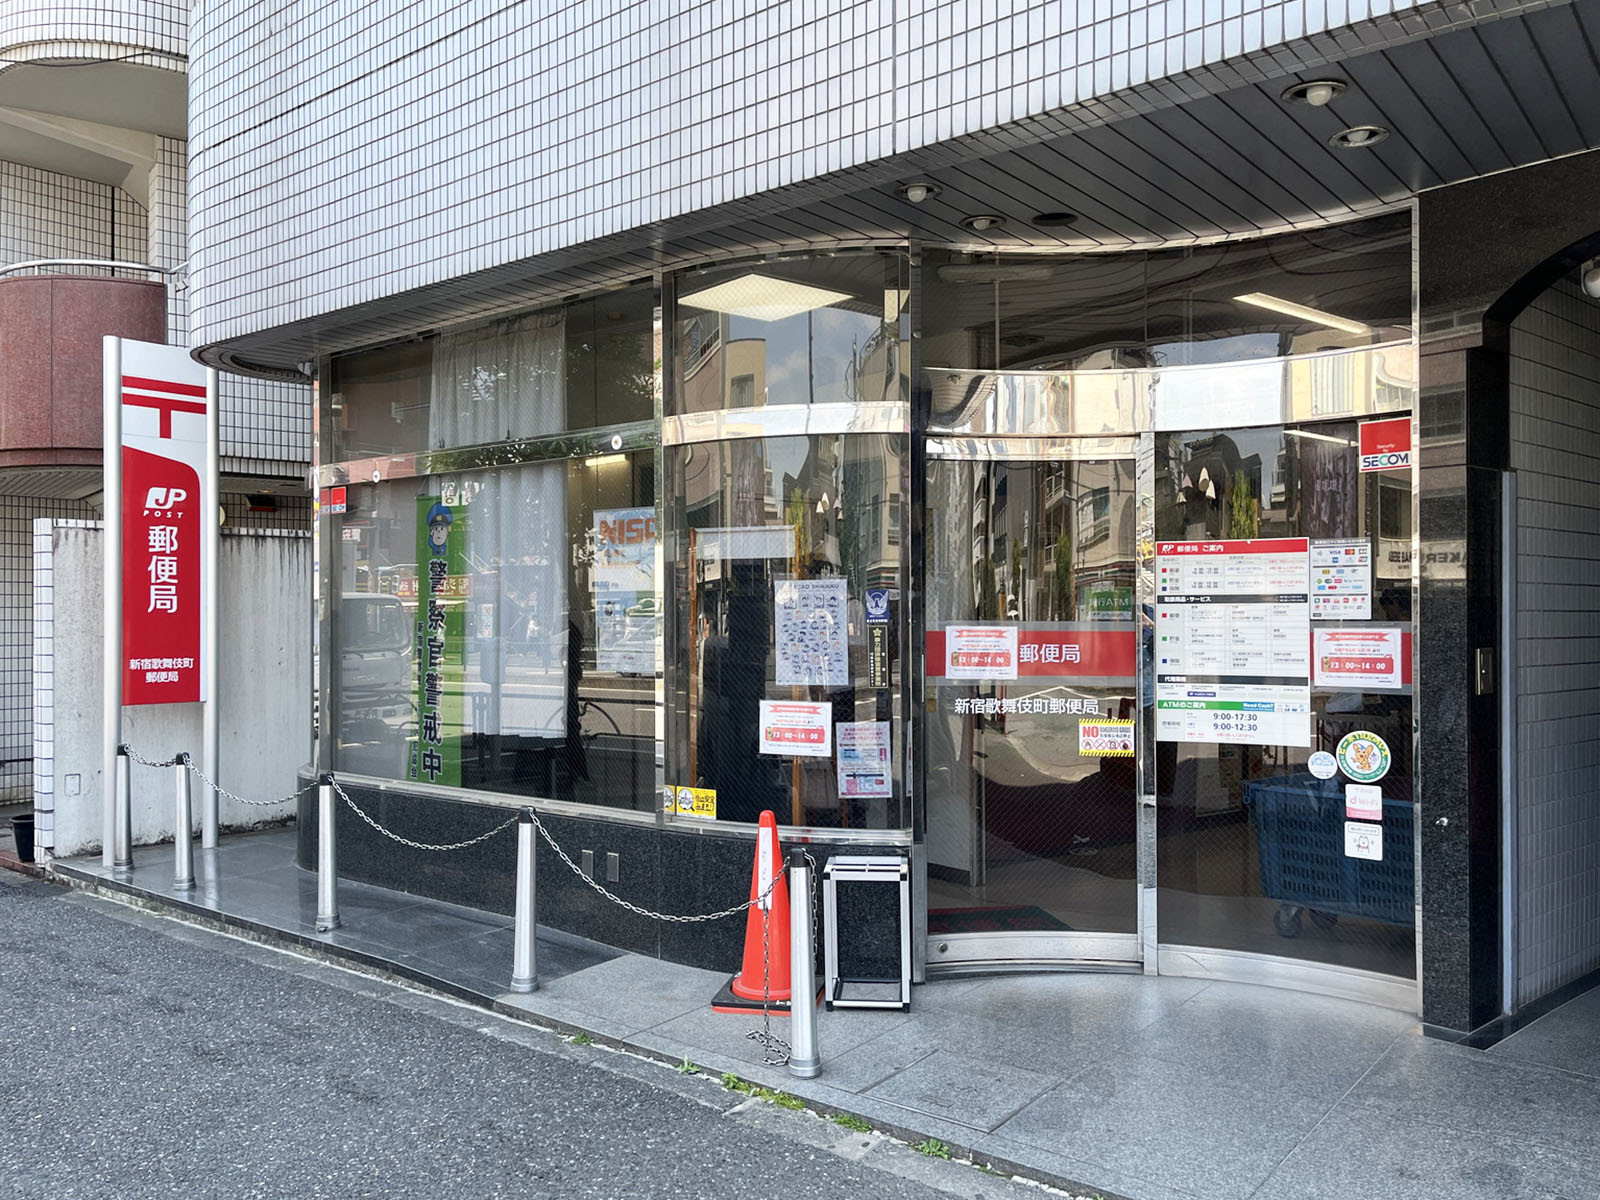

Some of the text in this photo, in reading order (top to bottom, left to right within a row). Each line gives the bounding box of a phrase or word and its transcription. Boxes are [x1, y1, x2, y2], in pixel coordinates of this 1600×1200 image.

[1363, 453, 1409, 467] SECOM
[143, 510, 183, 518] POST
[147, 525, 178, 613] 郵便局
[1019, 644, 1081, 663] 郵便局
[129, 658, 194, 670] 新宿歌舞伎町
[145, 671, 179, 683] 郵便局
[954, 698, 1099, 715] 新宿歌舞伎町郵便局
[1213, 712, 1258, 722] 9:00-17:30
[1082, 725, 1099, 738] NO
[1213, 723, 1258, 732] 9:00-12:30
